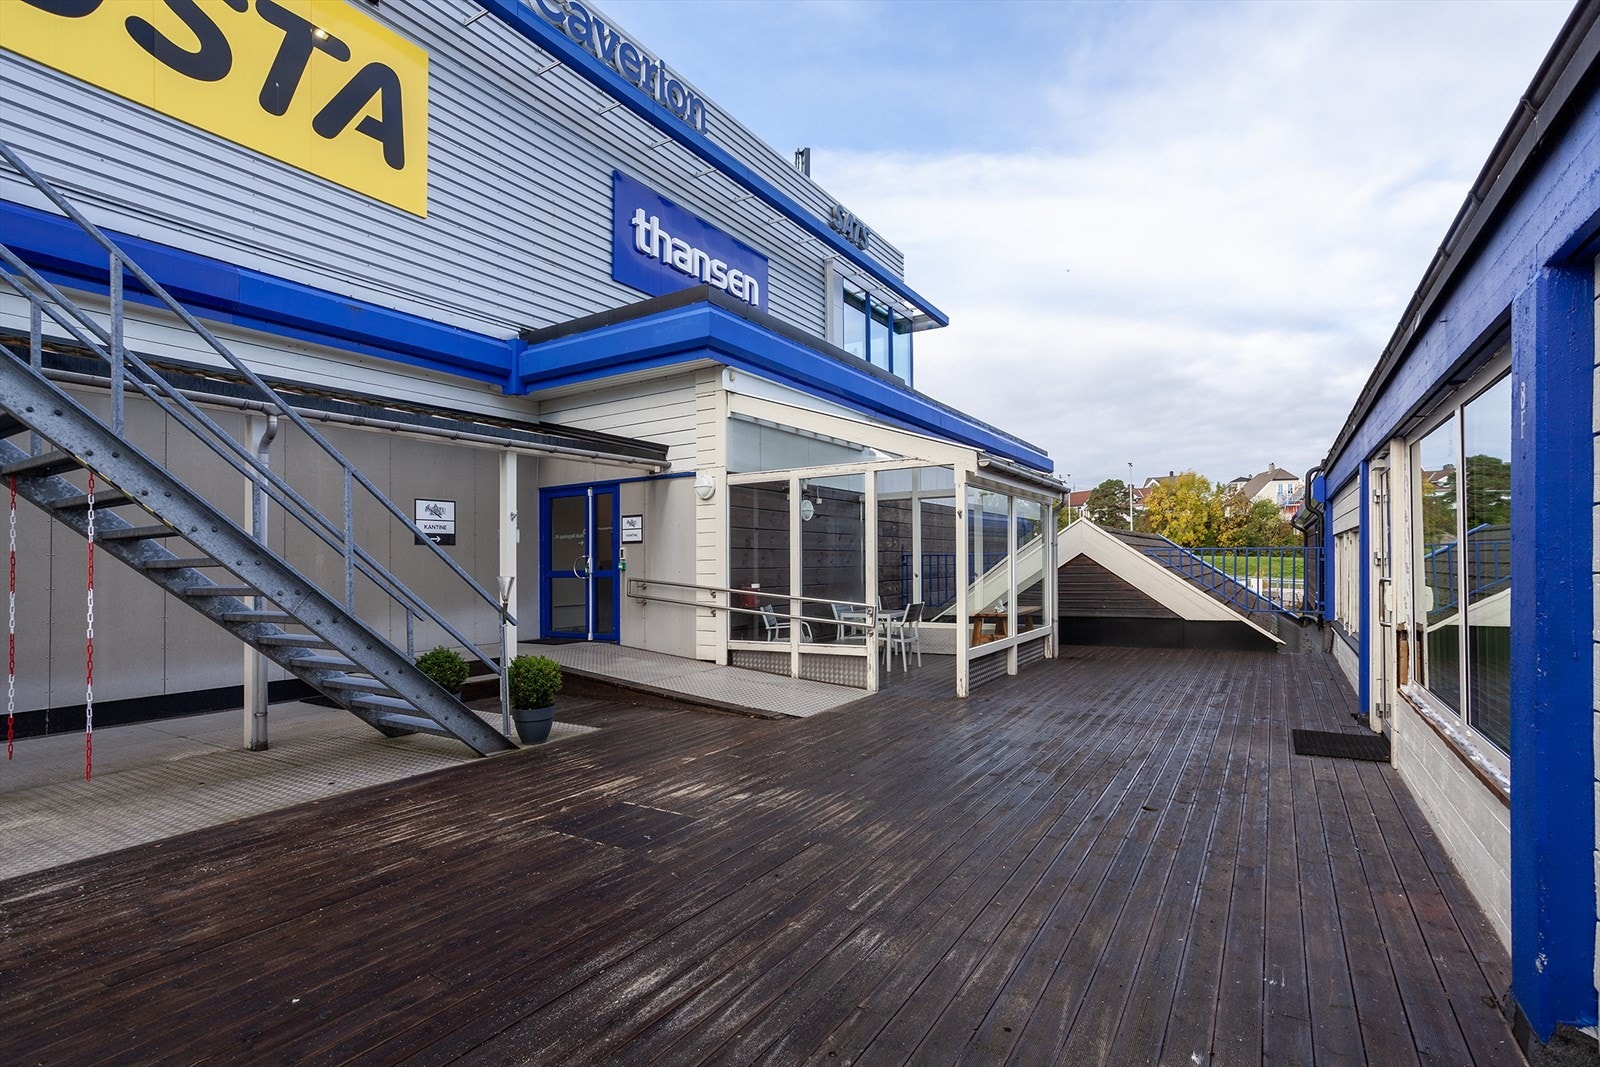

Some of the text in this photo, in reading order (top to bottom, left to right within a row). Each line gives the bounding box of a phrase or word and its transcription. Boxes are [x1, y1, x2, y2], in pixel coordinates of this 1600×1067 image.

[20, 0, 405, 170] STA
[631, 208, 759, 306] thansen
[829, 204, 870, 250] SATS
[423, 523, 448, 531] KANTINE
